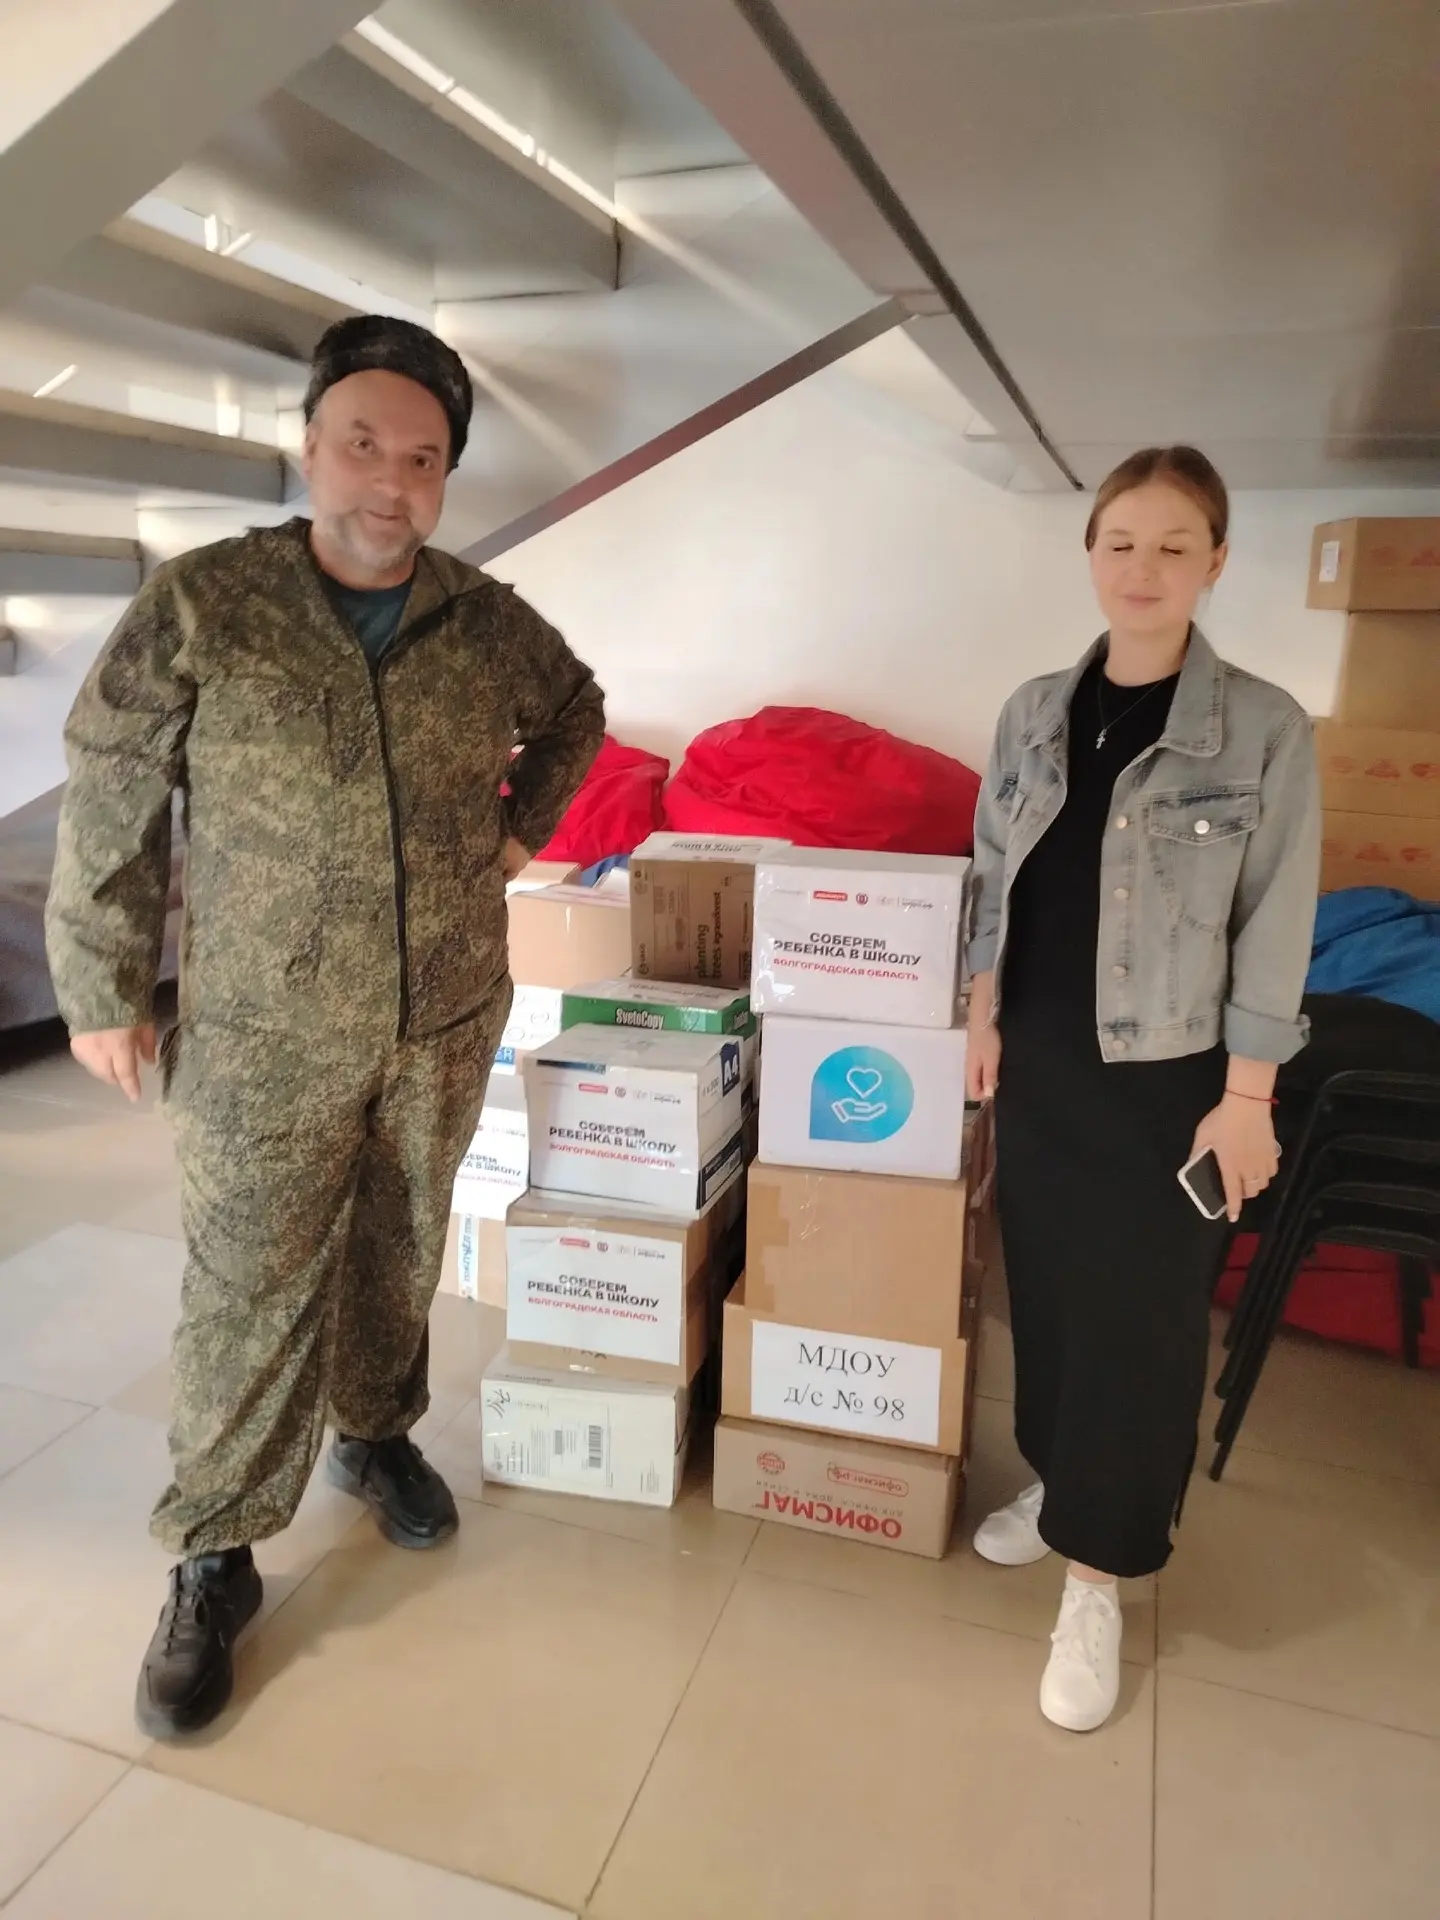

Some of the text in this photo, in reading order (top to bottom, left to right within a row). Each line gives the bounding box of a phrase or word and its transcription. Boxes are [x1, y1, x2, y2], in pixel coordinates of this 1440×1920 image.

[773, 940, 923, 966] РЕБЕНКА В ШКОЛУ
[810, 932, 887, 950] СОБЕРЕМ
[773, 958, 920, 982] ВОЛГОГРАДСКАЯ ОБЛАСТЬ
[615, 1008, 665, 1030] SvetoCopy
[723, 1054, 739, 1086] A4
[549, 1126, 677, 1154] РЕБЕНКА В ШКОЛУ
[579, 1120, 646, 1138] СОБЕРЕМ
[549, 1143, 676, 1168] ВОЛГОГРАДСКАЯ ОБЛАСТЬ
[527, 1280, 660, 1309] РЕБЕНКА В ШКОЛУ
[558, 1274, 627, 1293] СОБЕРЕМ
[528, 1296, 658, 1323] ВОЛГОГРАДСКАЯ ОБЛАСТЬ
[798, 1341, 897, 1378] МДОУ
[783, 1383, 906, 1421] д/с № 98
[756, 1489, 903, 1540] ОФИСМАГ
